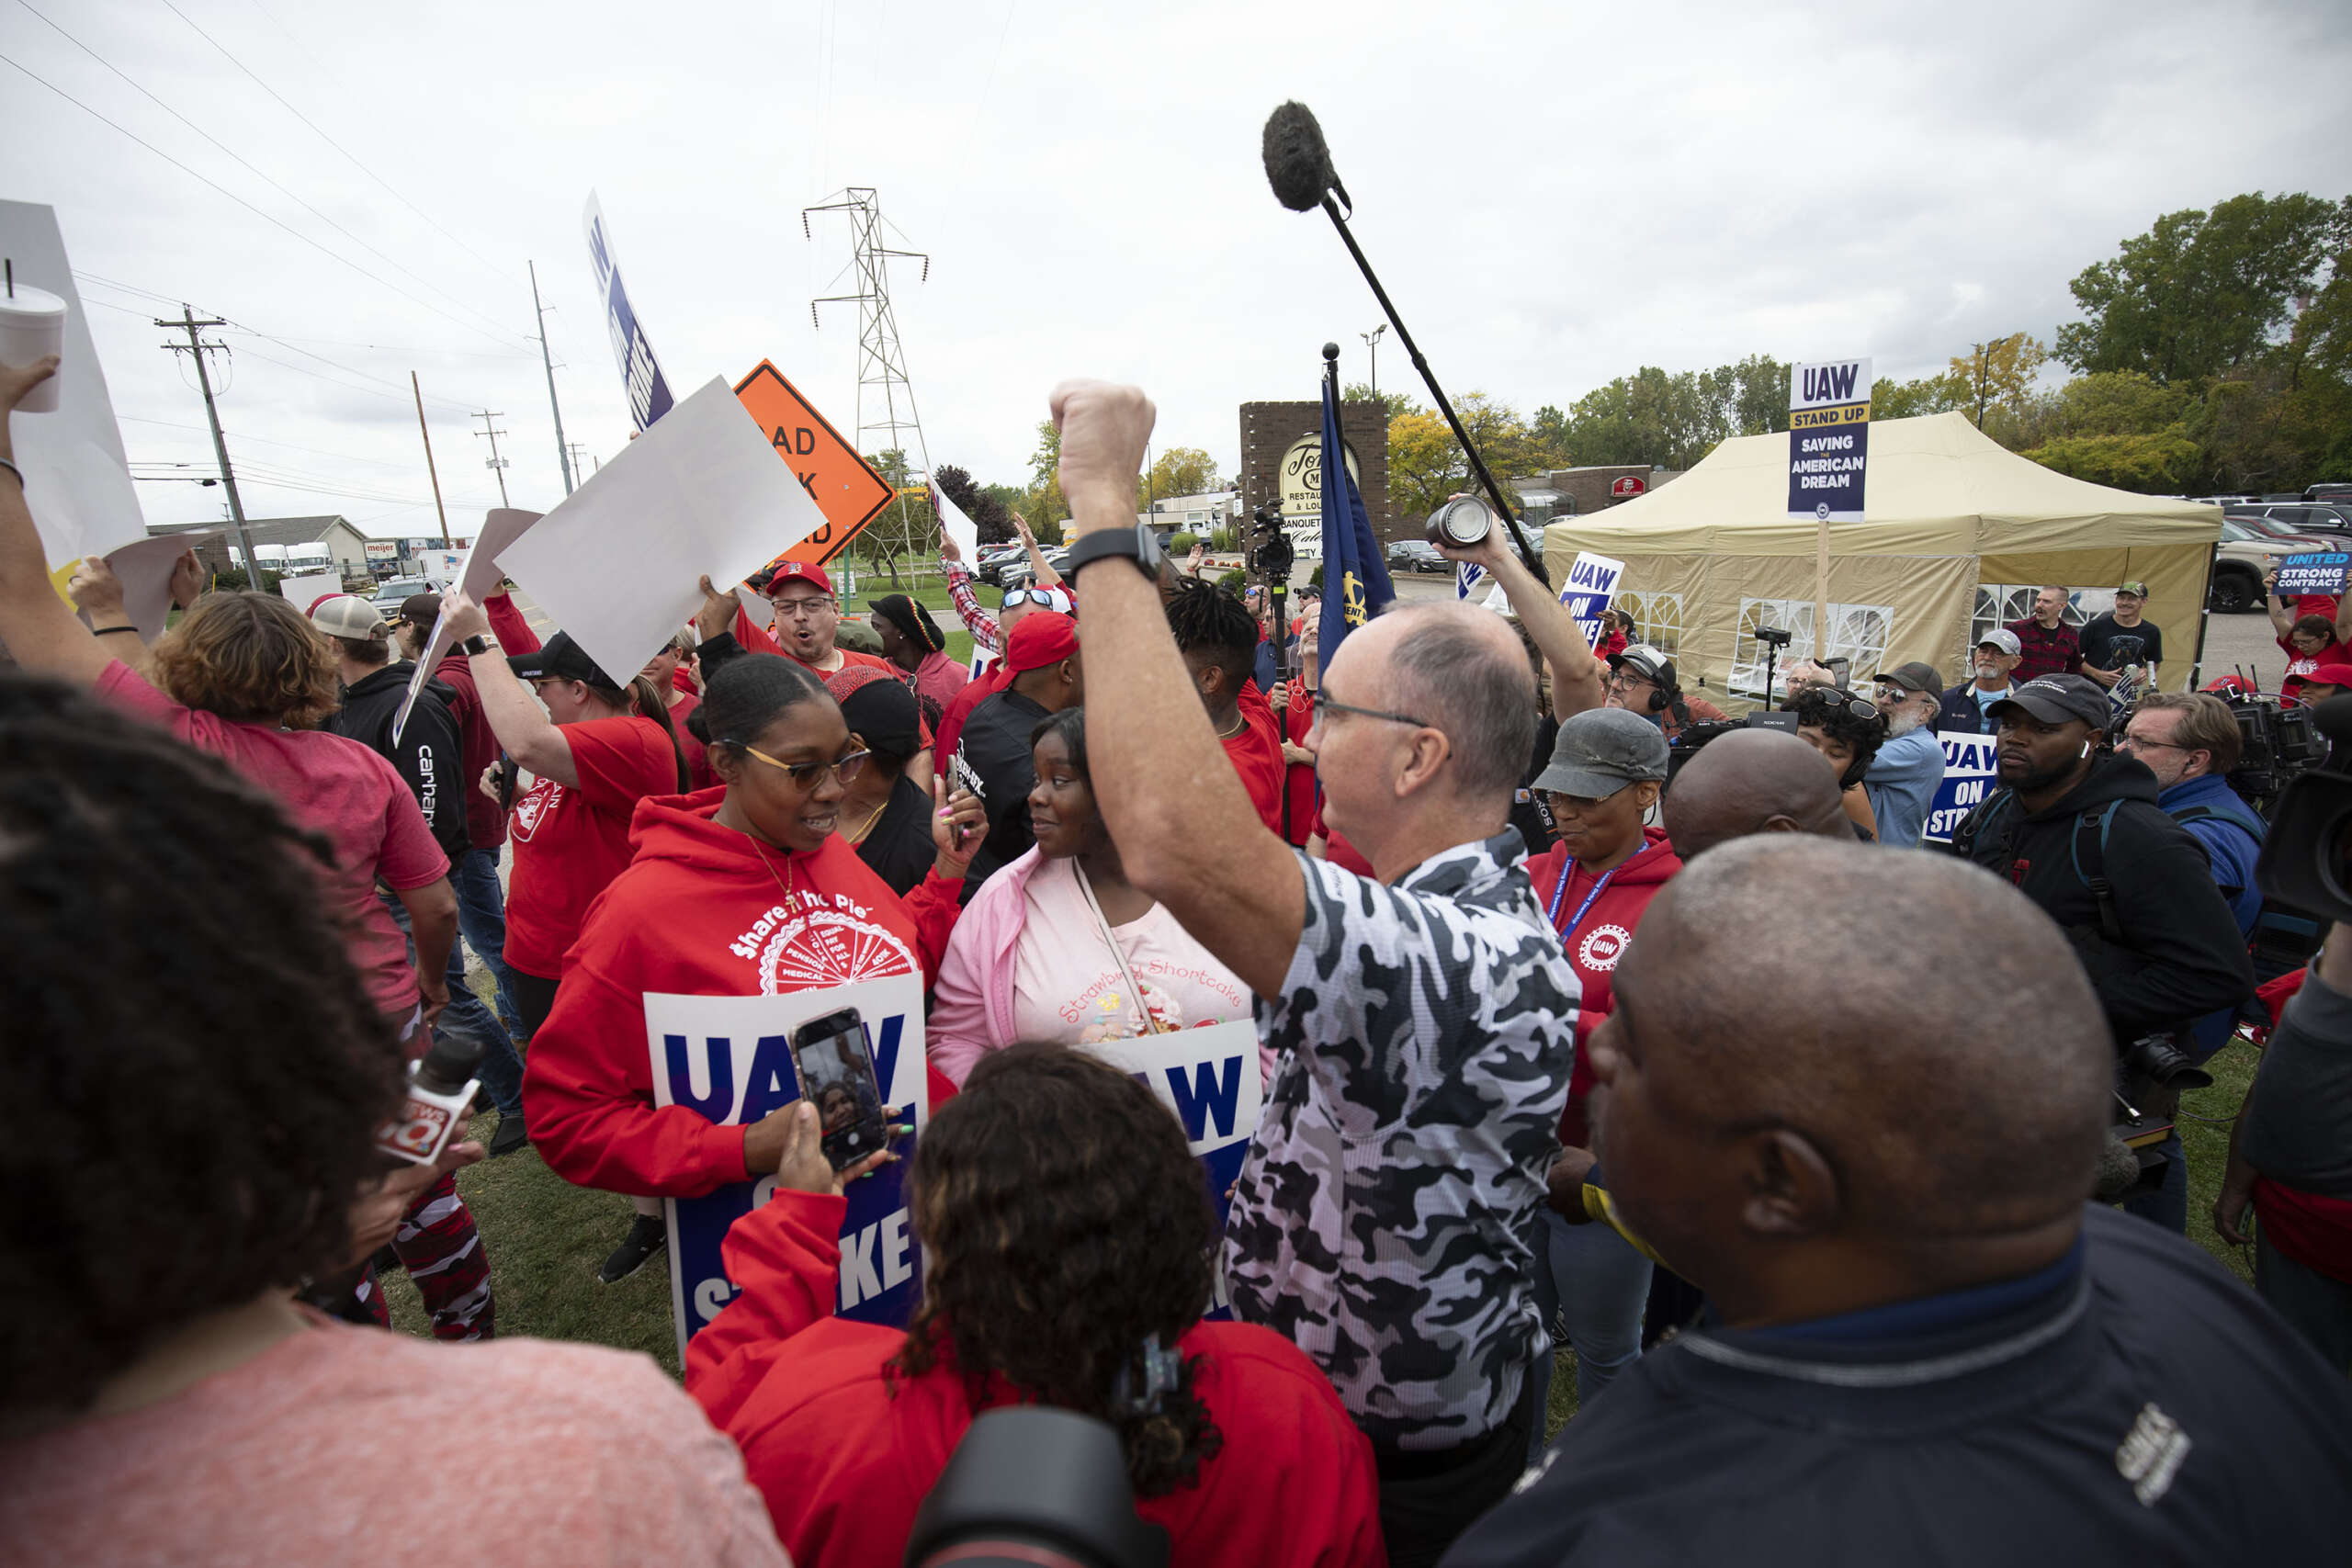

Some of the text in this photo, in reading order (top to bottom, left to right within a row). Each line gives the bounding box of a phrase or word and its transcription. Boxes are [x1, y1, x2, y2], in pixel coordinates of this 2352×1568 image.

[1804, 364, 1859, 402] UAW
[1794, 407, 1865, 426] STAND UP
[766, 425, 816, 456] AD
[1802, 434, 1854, 453] SAVING
[1792, 456, 1865, 474] AMERICAN
[1801, 474, 1850, 489] DREAM
[1282, 518, 1321, 528] BANQUET
[368, 543, 394, 554] meijer
[2286, 553, 2349, 566] UNITED
[1571, 560, 1617, 592] UAW
[2280, 569, 2343, 579] STRONG
[2278, 579, 2343, 587] CONTRACT
[1571, 597, 1591, 617] ON
[1955, 781, 1984, 806] ON
[830, 942, 845, 953] FOR
[1591, 939, 1618, 956] UAW
[786, 948, 825, 971] PENSION
[836, 952, 851, 961] ALL
[871, 948, 891, 965] 401K
[782, 968, 826, 982] MEDICAL
[1148, 959, 1242, 1008] Shortcake
